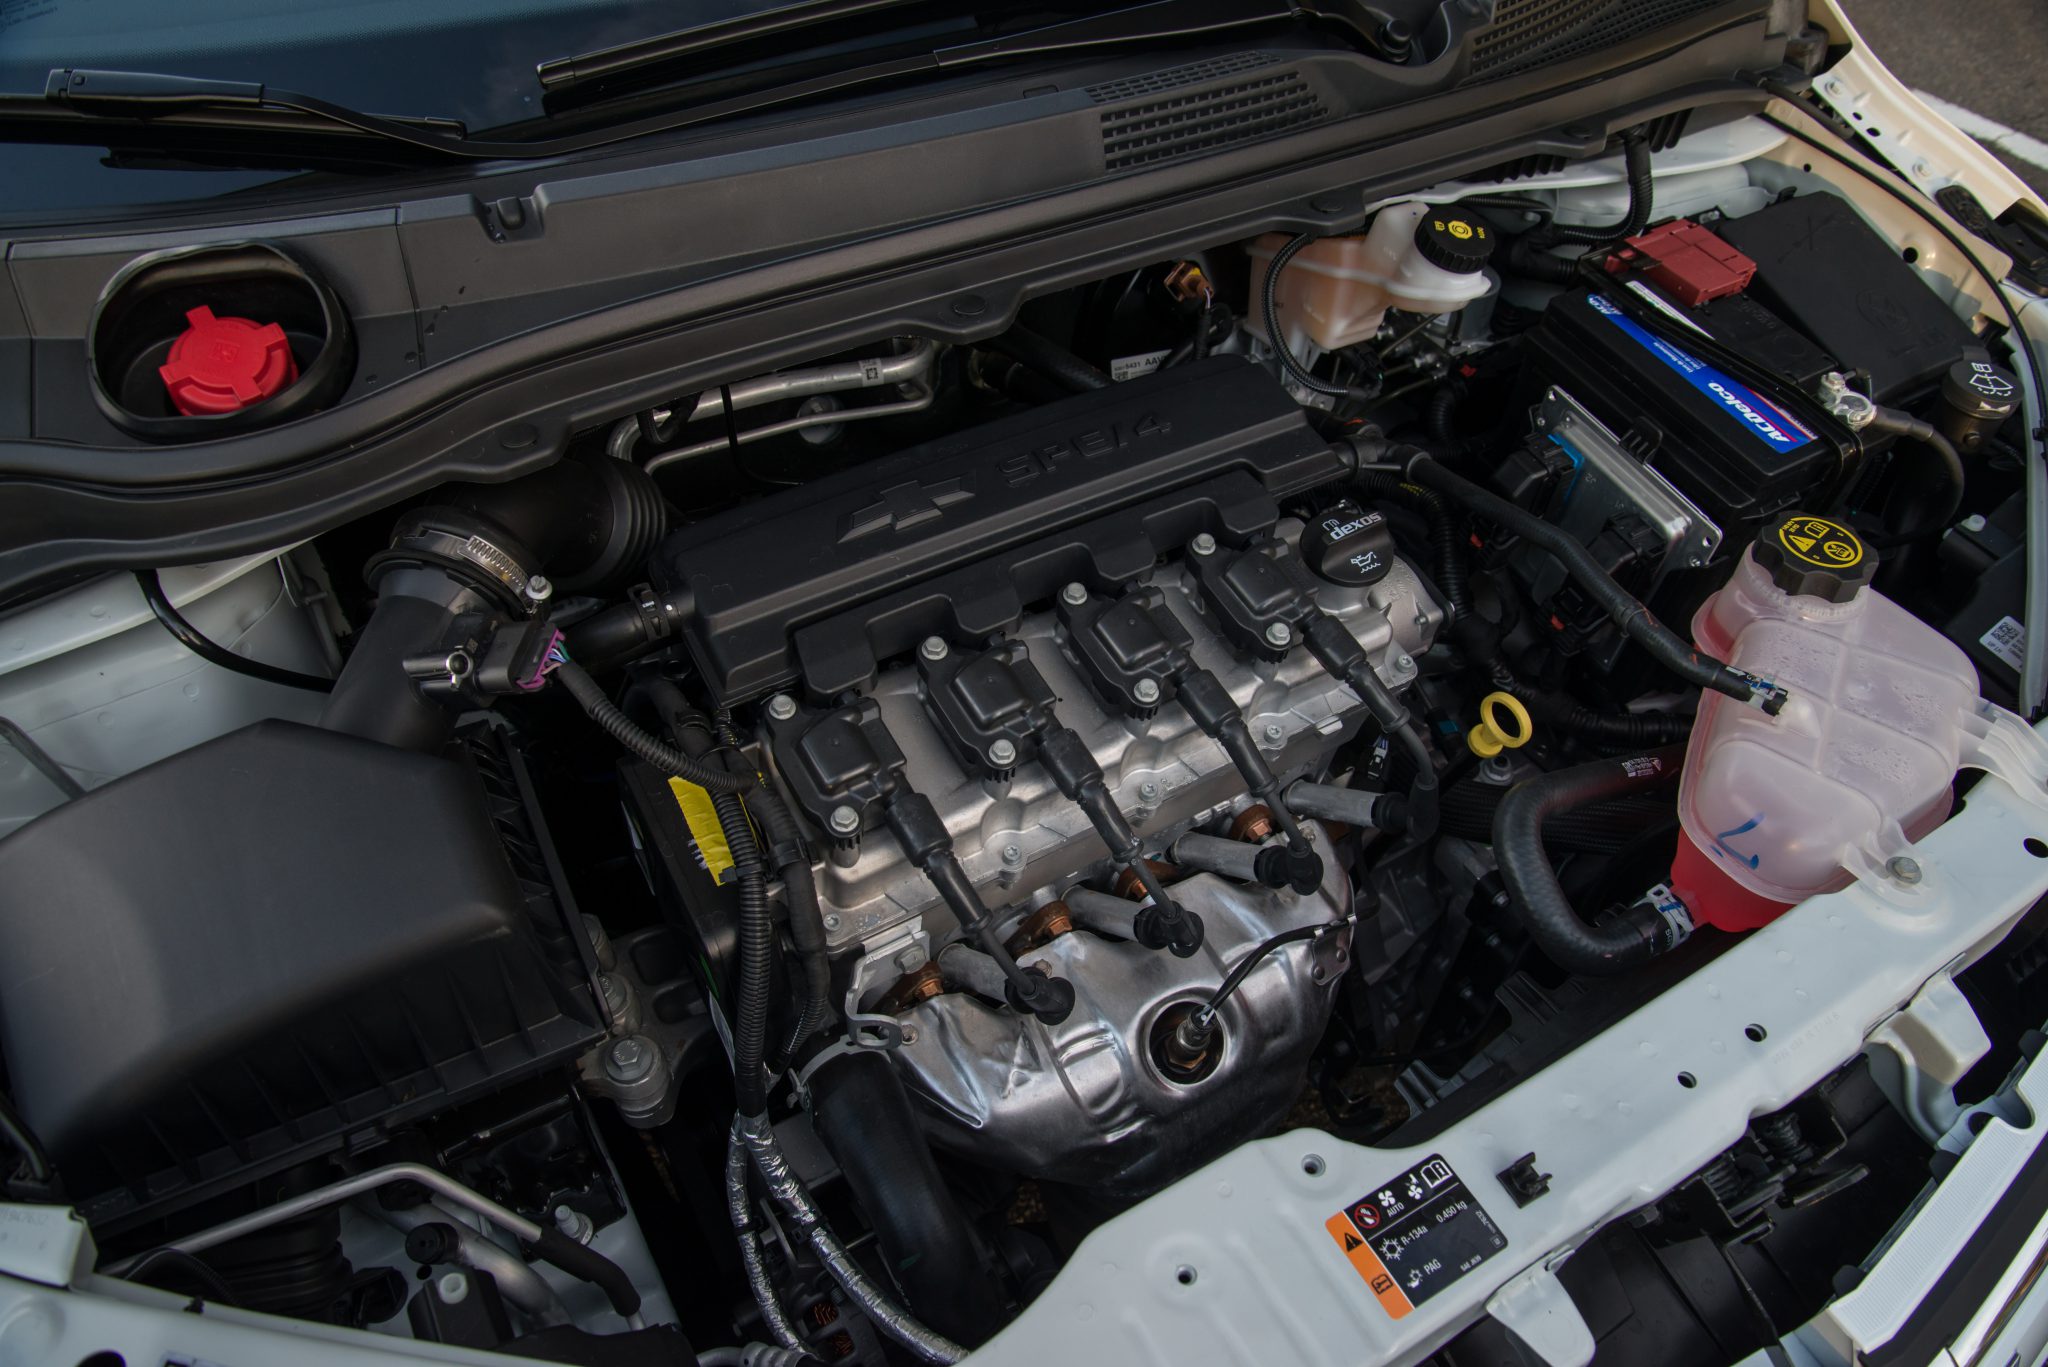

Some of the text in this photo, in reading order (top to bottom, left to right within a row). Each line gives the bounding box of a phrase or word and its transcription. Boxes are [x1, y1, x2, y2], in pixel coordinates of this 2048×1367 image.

[1707, 382, 1791, 443] ACDelco
[1330, 512, 1382, 540] dexos
[1386, 1202, 1405, 1218] AUTO
[1400, 1200, 1468, 1246] R-134a 0.450 kg
[1423, 1258, 1442, 1275] PAG
